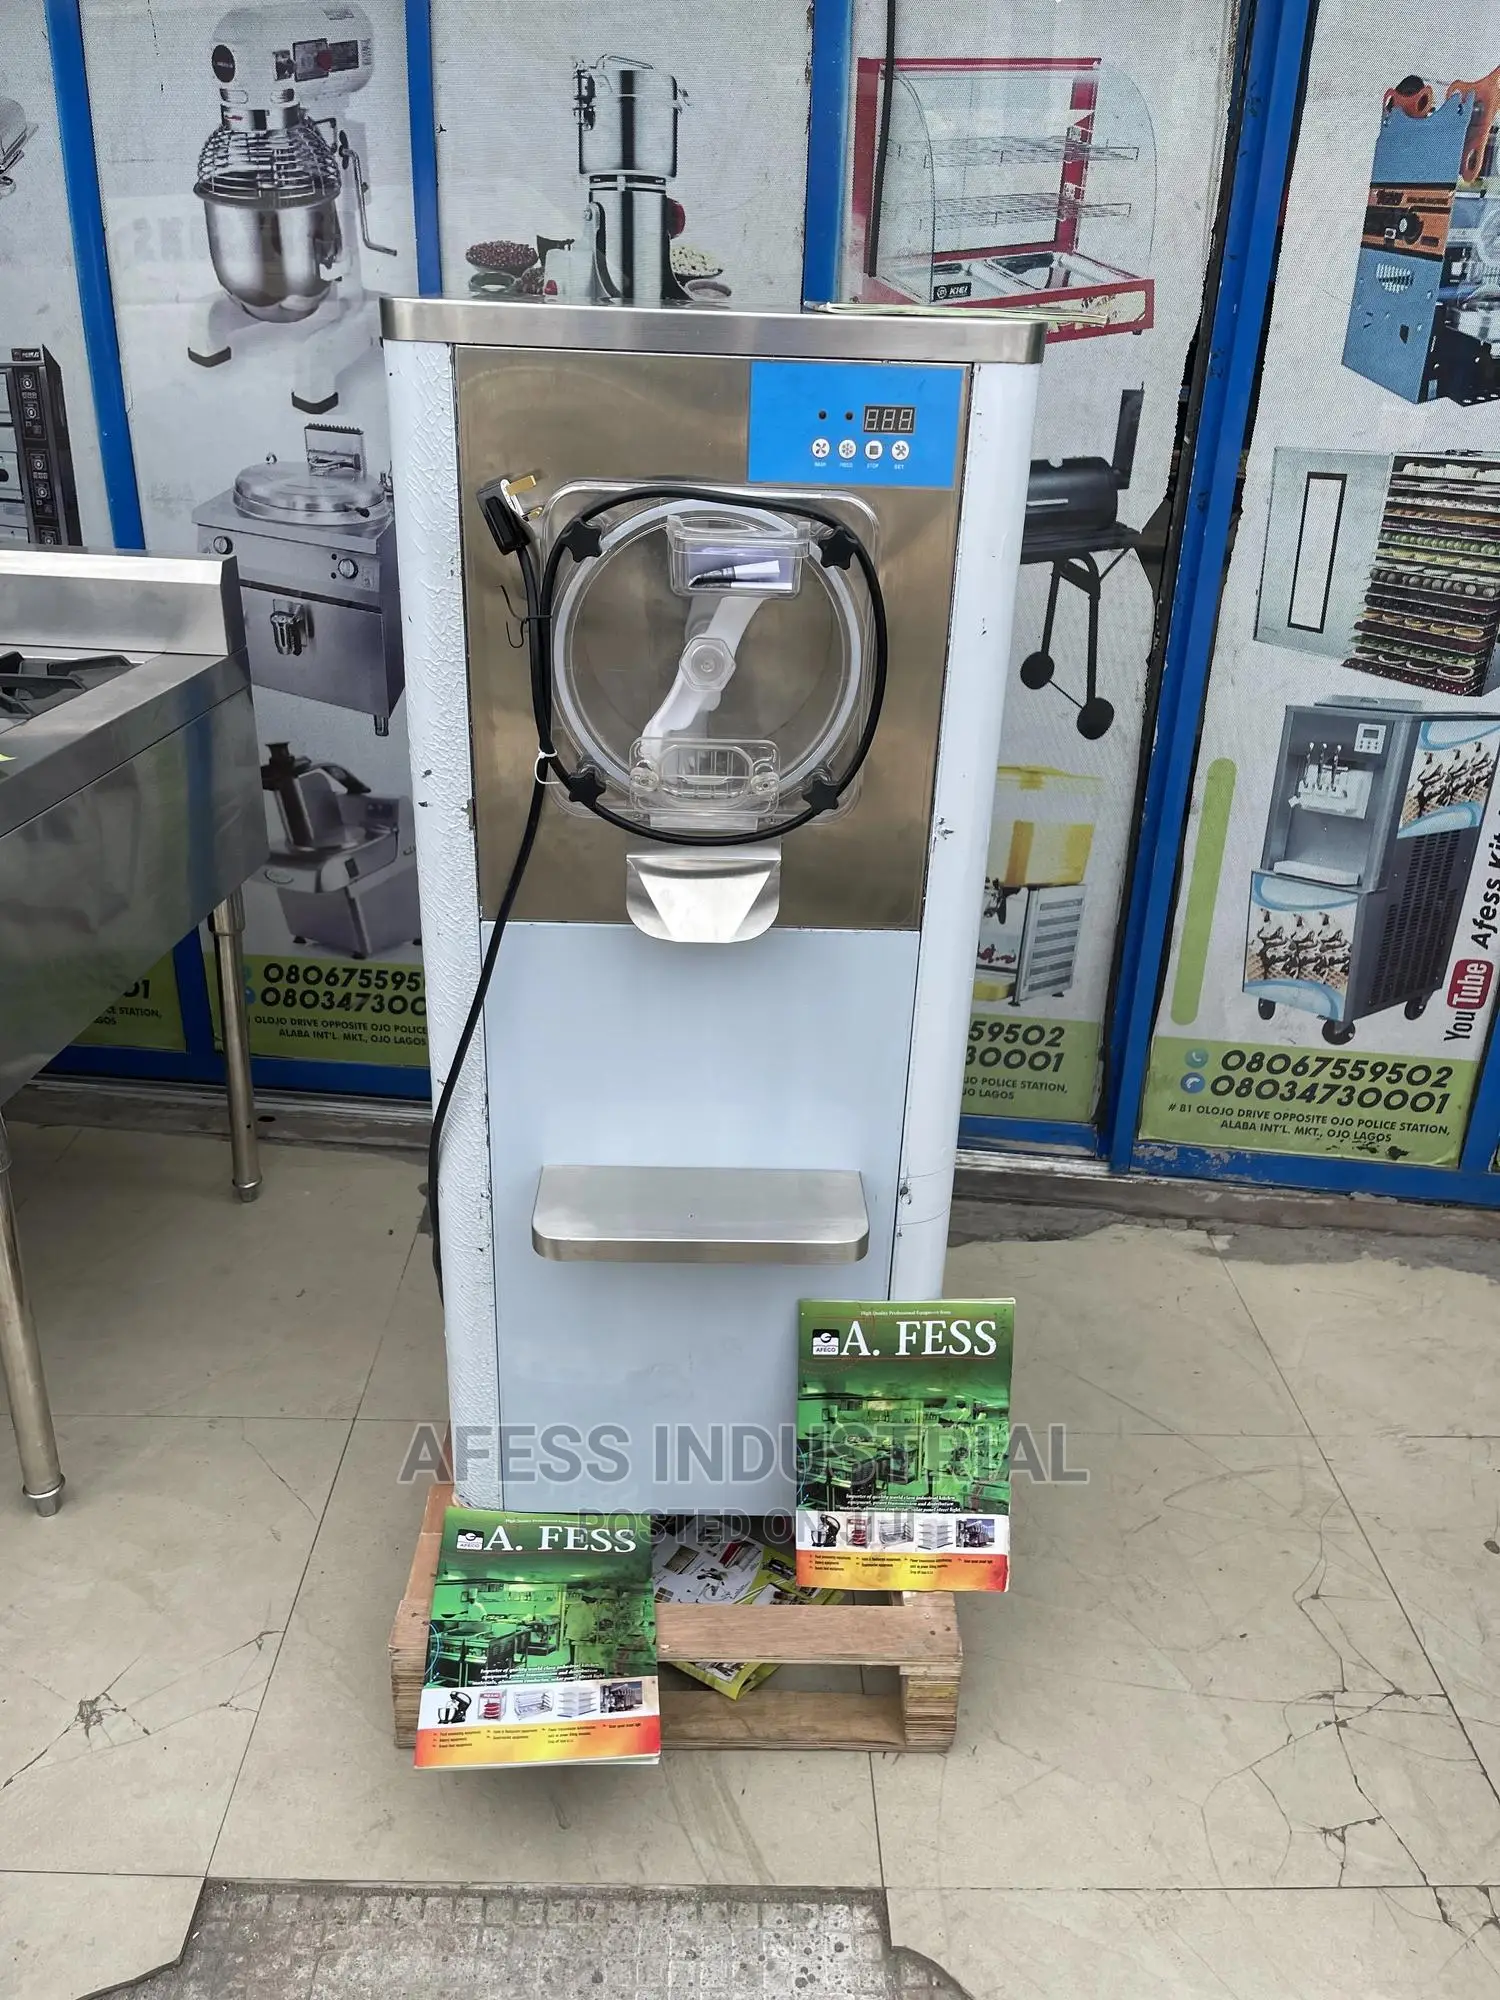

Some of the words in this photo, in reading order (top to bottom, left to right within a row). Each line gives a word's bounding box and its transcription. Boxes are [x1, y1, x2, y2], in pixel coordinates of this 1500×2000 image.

[1470, 877, 1500, 950] Afess
[263, 963, 426, 993] 080675595
[279, 1028, 310, 1038] ALABA
[370, 1035, 391, 1043] OJO
[394, 1036, 427, 1046] LAGOS
[290, 1017, 319, 1028] DRIVE
[321, 1020, 368, 1031] OPPOSITE
[370, 1023, 391, 1032] OJO
[968, 1020, 1065, 1047] 59502
[1221, 1049, 1454, 1089] 08067559502
[979, 1088, 1014, 1100] LAGOS
[981, 1077, 1017, 1089] POLICE
[1020, 1080, 1068, 1094] STATION,
[1210, 1075, 1452, 1115] 08034730001
[1196, 1105, 1234, 1117] OLOJO
[1237, 1108, 1271, 1119] DRIVE
[1273, 1111, 1328, 1125] OPPOSITE
[1330, 1116, 1354, 1127] OJO
[1357, 1119, 1397, 1130] POLICE
[1399, 1122, 1450, 1136] STATION,
[1220, 1119, 1257, 1131] ALABA
[1327, 1129, 1350, 1139] OJO
[1354, 1131, 1392, 1142] LAGOS
[839, 1320, 881, 1357] A.
[895, 1319, 998, 1357] FESS
[484, 1525, 524, 1551] A.
[537, 1525, 637, 1553] FESS
